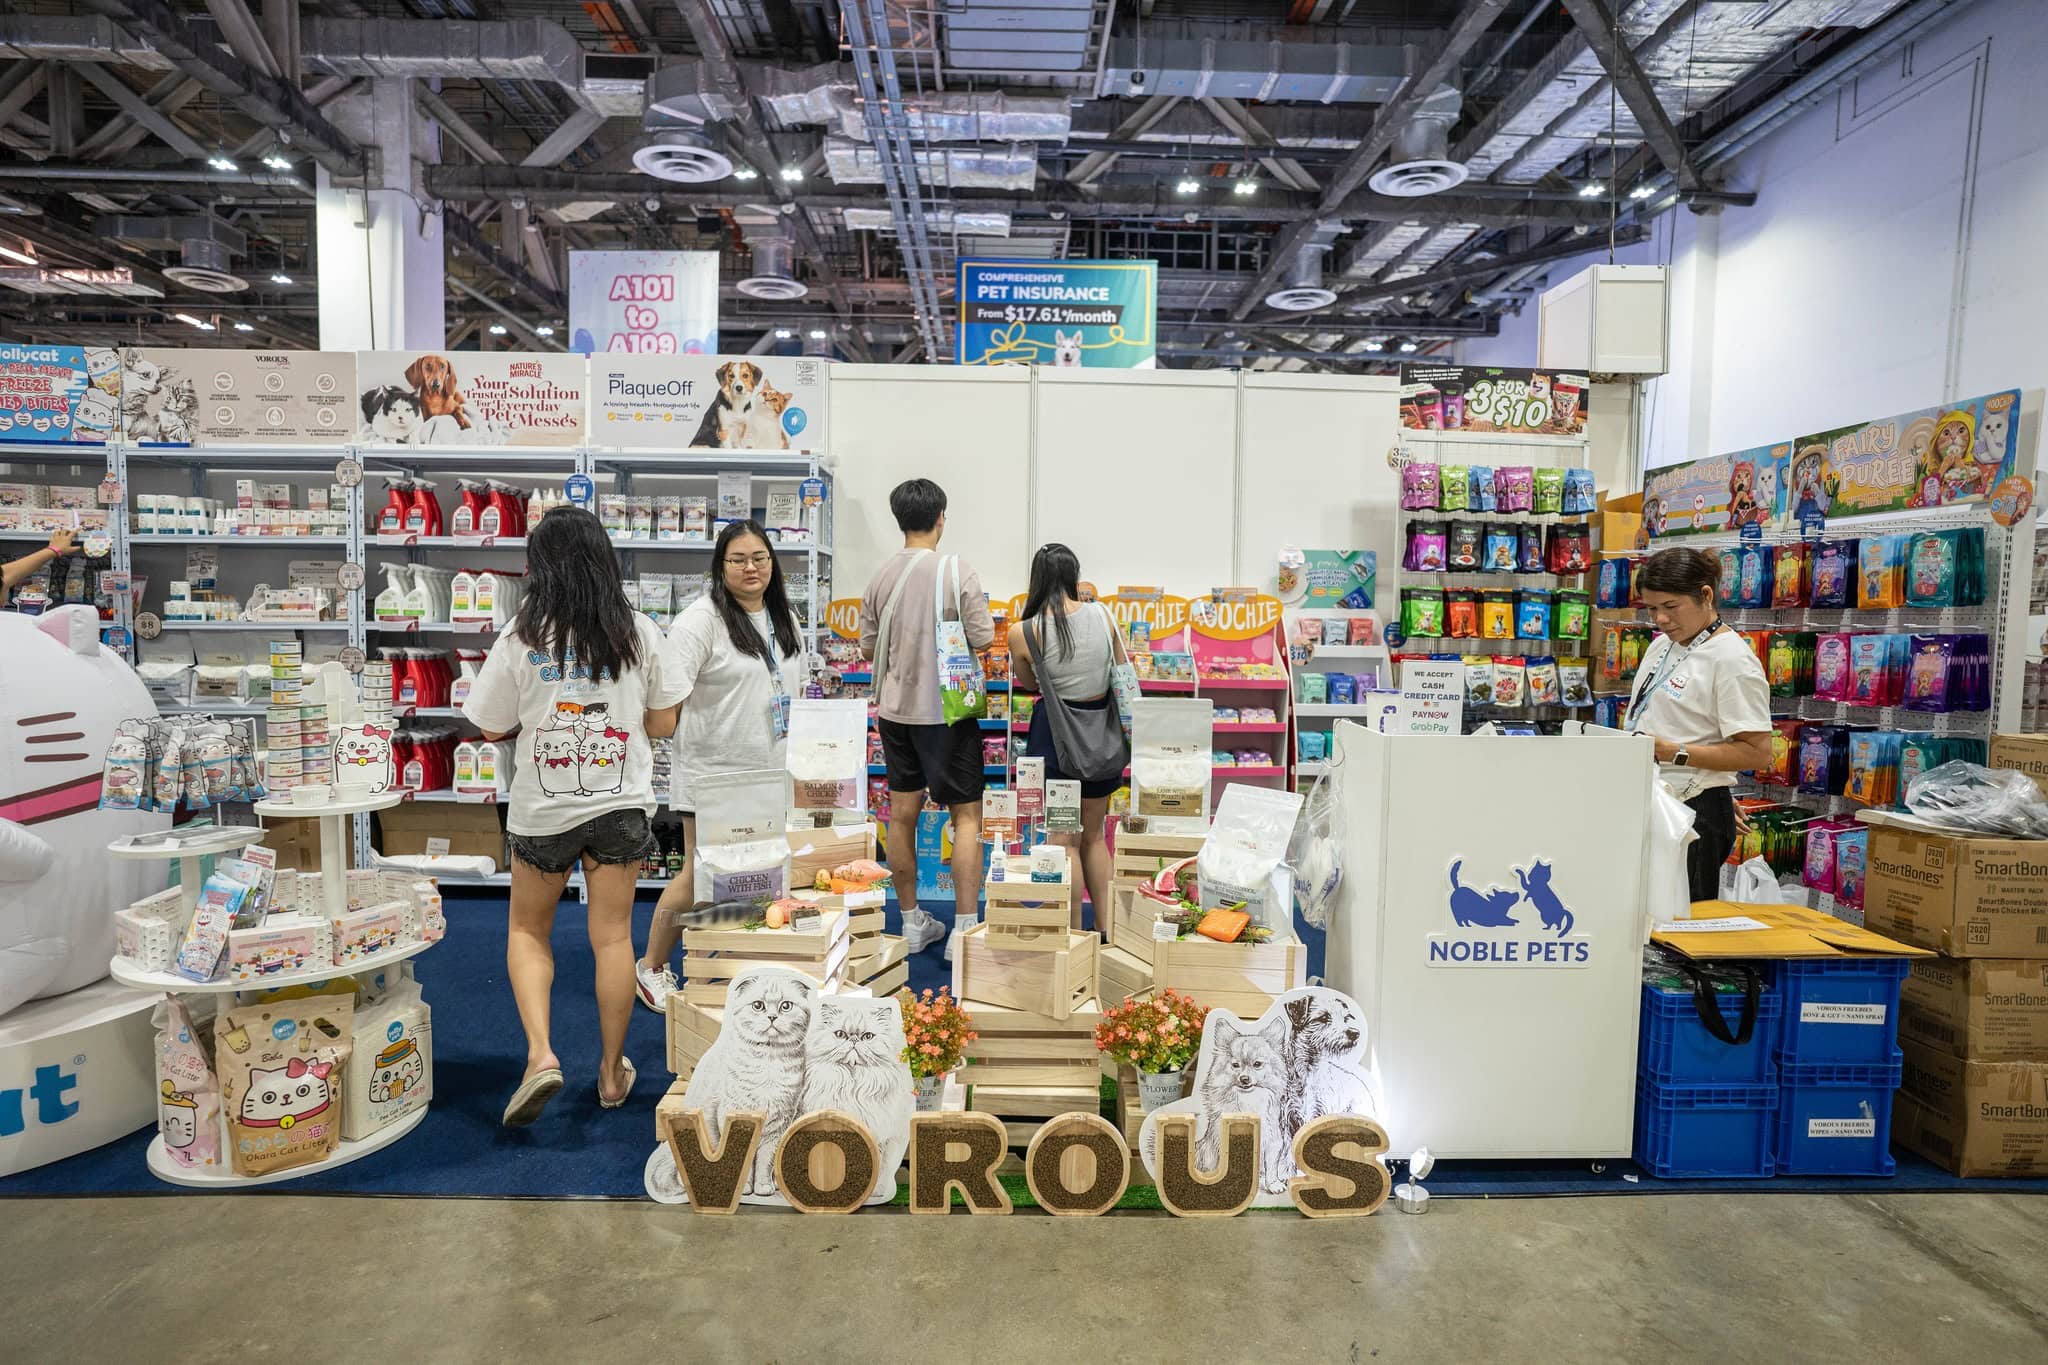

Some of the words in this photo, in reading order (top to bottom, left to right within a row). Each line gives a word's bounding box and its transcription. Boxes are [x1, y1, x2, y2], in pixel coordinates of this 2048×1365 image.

[978, 272, 1065, 283] COMPREHENSIVE
[609, 275, 674, 301] A101
[977, 285, 1009, 299] PET
[1013, 286, 1109, 301] INSURANCE
[625, 304, 659, 330] to
[977, 308, 1003, 319] From
[474, 375, 509, 389] Your
[510, 370, 542, 378] MIRACLE
[464, 388, 507, 400] Trusted
[509, 381, 580, 400] Solution
[609, 380, 694, 399] PlaqueOff
[1472, 381, 1493, 414] 3
[1496, 381, 1526, 396] FOR
[26, 396, 70, 412] BITES
[493, 399, 560, 414] Everyday
[1494, 397, 1547, 427] $10
[480, 408, 510, 421] Pet
[509, 413, 577, 429] Messes
[1833, 422, 1895, 462] FAIRY
[1840, 449, 1915, 492] PURÉE
[1652, 466, 1688, 493] FAIRY
[1404, 692, 1434, 700] CREDIT
[1437, 693, 1460, 701] CARD
[1412, 711, 1449, 719] PAYNOW
[1411, 722, 1449, 733] GrabPay
[804, 783, 837, 791] SALMON
[838, 783, 844, 791] &
[807, 790, 843, 798] CHICKEN
[1873, 857, 1941, 884] SmartBones
[1975, 860, 2048, 876] SmartBon
[729, 873, 768, 884] CHICKEN
[728, 884, 752, 893] WITH
[753, 881, 772, 891] FISH
[1978, 897, 2022, 906] SmartBones
[1976, 906, 2000, 914] Bones
[2001, 906, 2029, 915] Chicken
[2031, 907, 2046, 915] Mini
[1970, 926, 1988, 935] 2020
[1971, 934, 1985, 942] -10
[1430, 941, 1519, 962] NOBLE
[1527, 941, 1589, 962] PETS
[170, 1065, 181, 1075] Cat
[181, 1069, 201, 1081] Litter
[183, 1151, 193, 1162] 7L
[246, 1152, 277, 1162] Okara
[280, 1145, 299, 1155] Cat
[655, 1110, 1391, 1218] VOROUS
